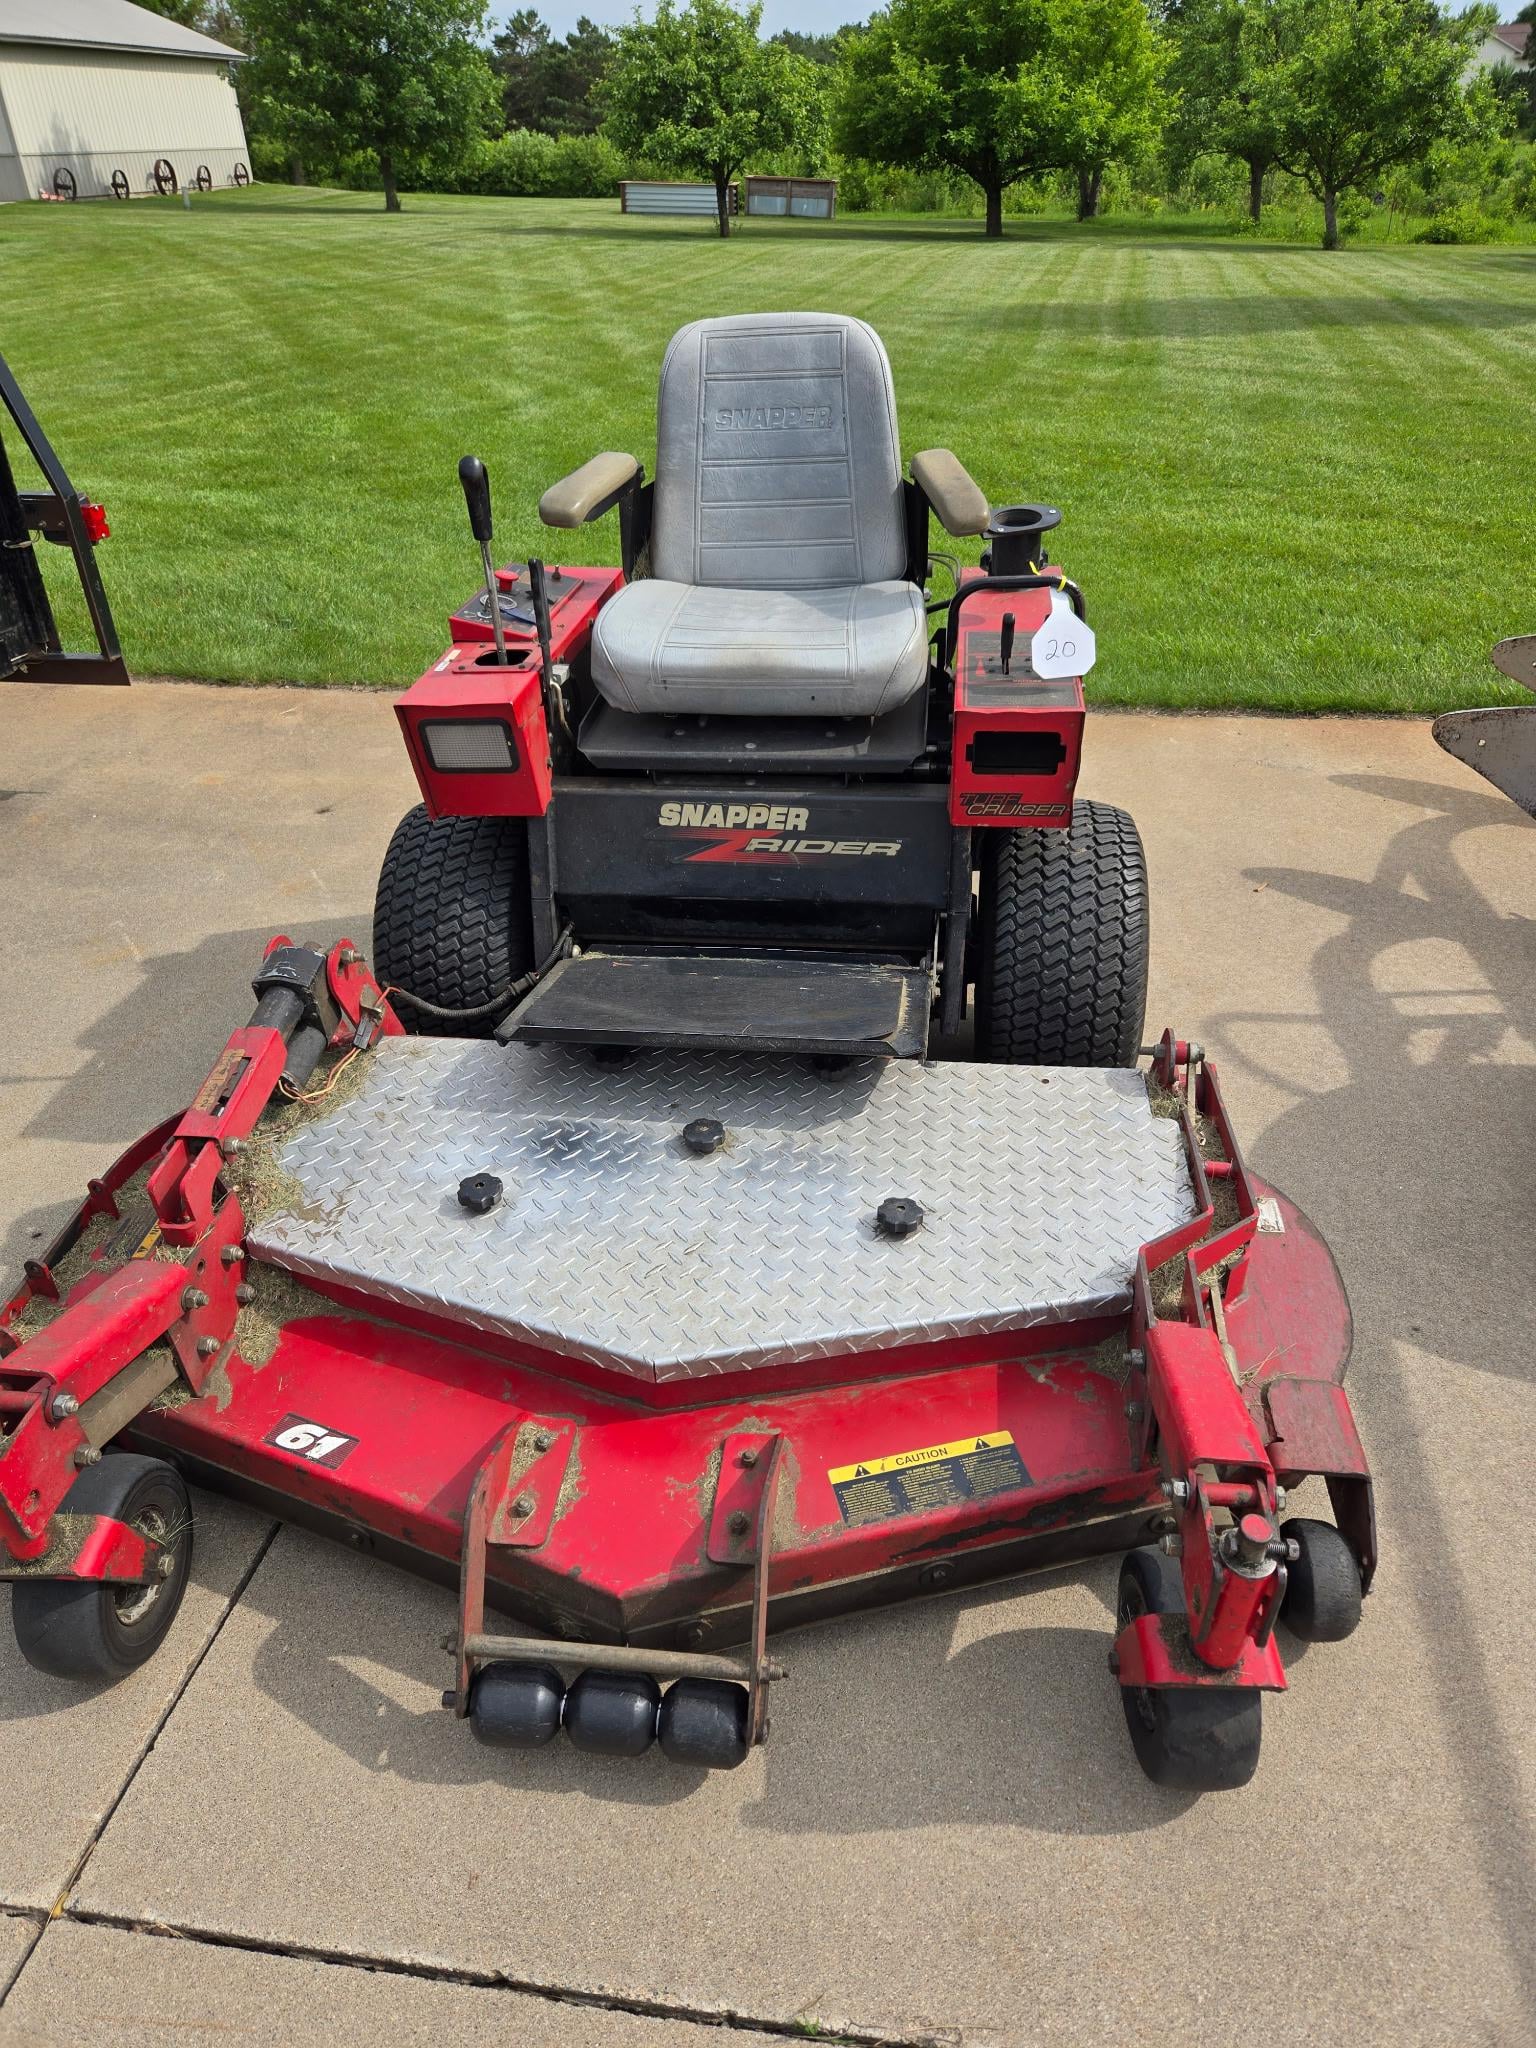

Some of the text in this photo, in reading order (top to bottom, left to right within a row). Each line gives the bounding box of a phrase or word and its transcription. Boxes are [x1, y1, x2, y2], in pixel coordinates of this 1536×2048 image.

[715, 406, 832, 430] SNAPPER
[1045, 639, 1076, 661] 20
[658, 803, 810, 831] SNAPPER
[966, 804, 1067, 816] CRUISER
[275, 1423, 350, 1460] 61
[895, 1447, 948, 1466] CAUTION
